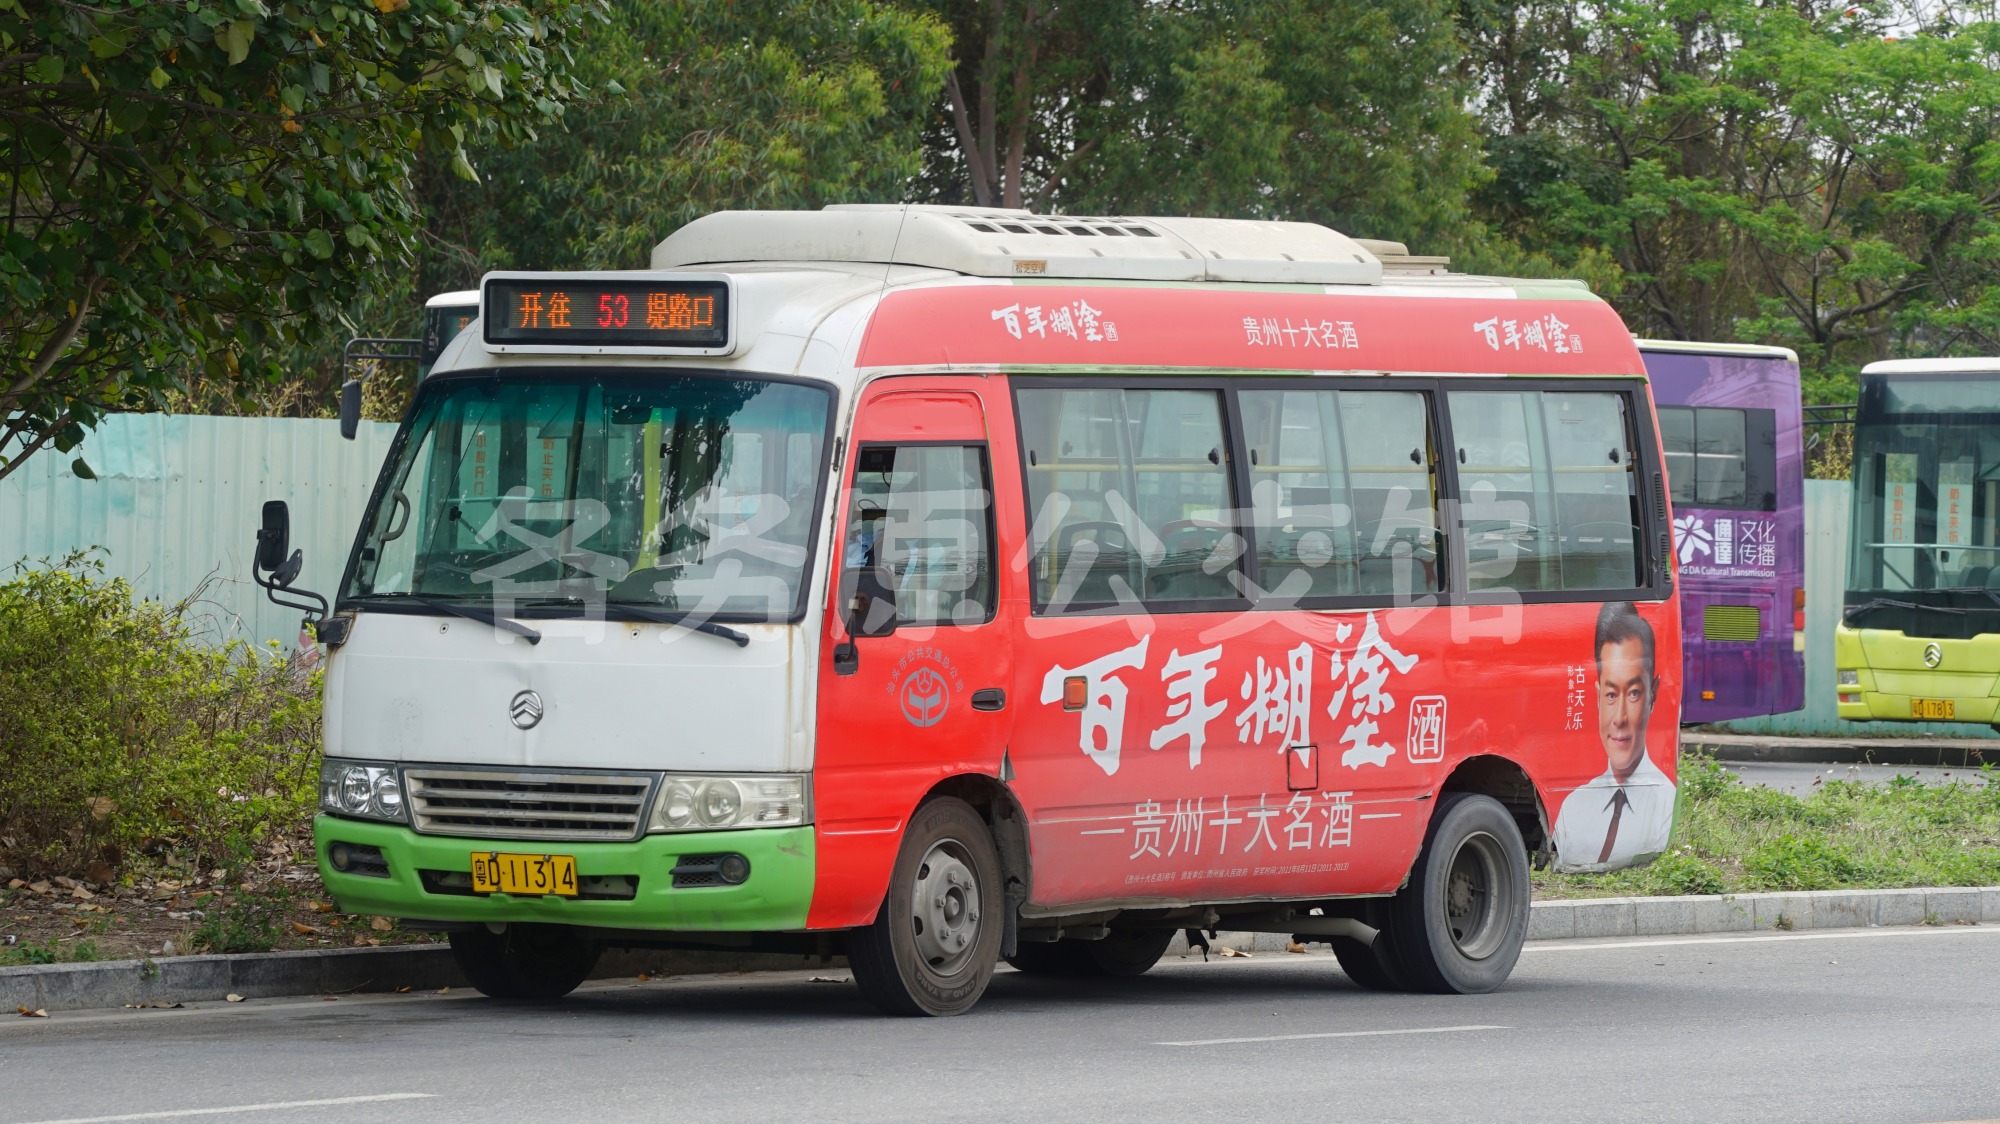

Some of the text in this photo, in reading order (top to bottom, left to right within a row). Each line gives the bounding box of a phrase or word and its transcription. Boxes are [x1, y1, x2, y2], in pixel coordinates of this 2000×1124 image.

[519, 292, 713, 329] 开往 53 堤路口
[1242, 316, 1359, 350] 贵州十大名酒
[1740, 520, 1776, 543] 文化
[1689, 566, 1700, 575] DA
[1701, 566, 1729, 576] Cultural
[1730, 567, 1776, 578] Transmission
[1739, 544, 1776, 566] 传播
[1565, 665, 1575, 731] 形象代言人
[1572, 665, 1586, 730] 古天乐
